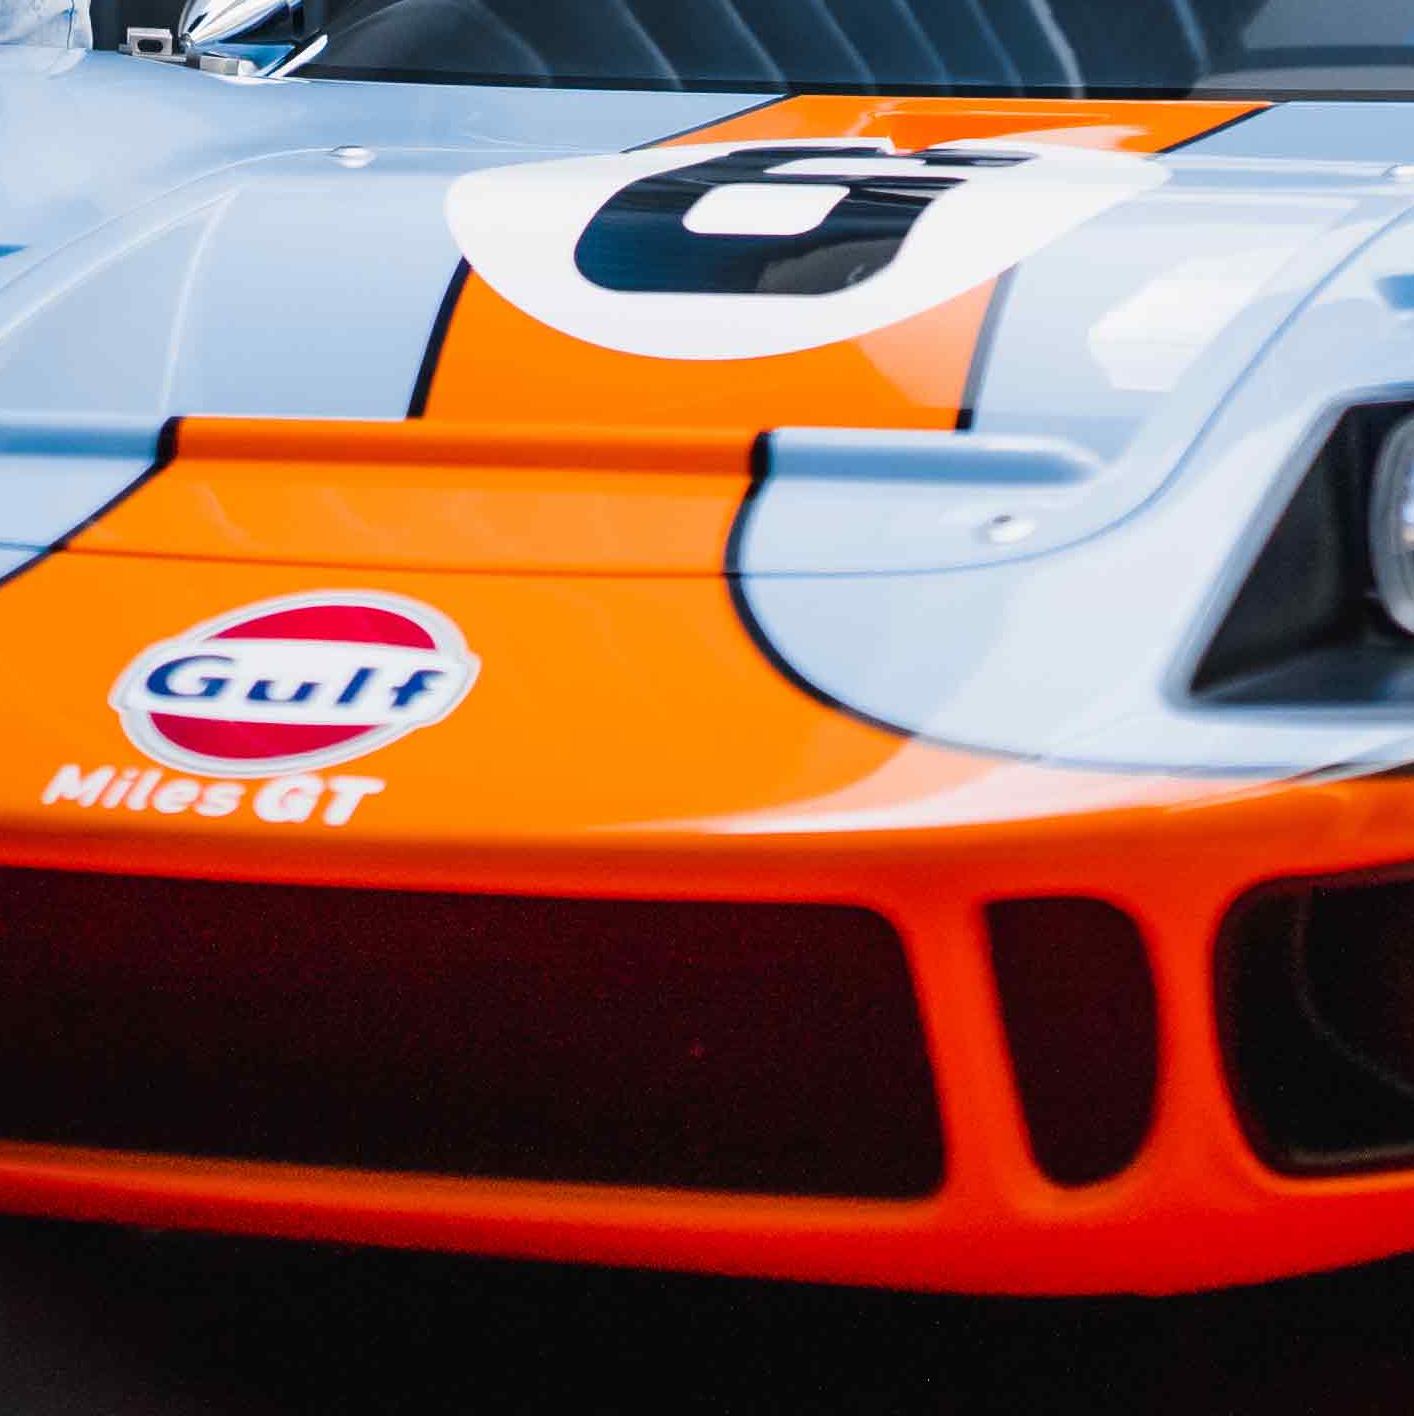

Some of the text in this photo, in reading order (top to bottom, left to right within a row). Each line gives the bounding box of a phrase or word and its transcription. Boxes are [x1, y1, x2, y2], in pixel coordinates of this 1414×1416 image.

[573, 146, 1044, 295] 6
[145, 655, 444, 709] Gulf
[41, 764, 387, 828] Miles GT
